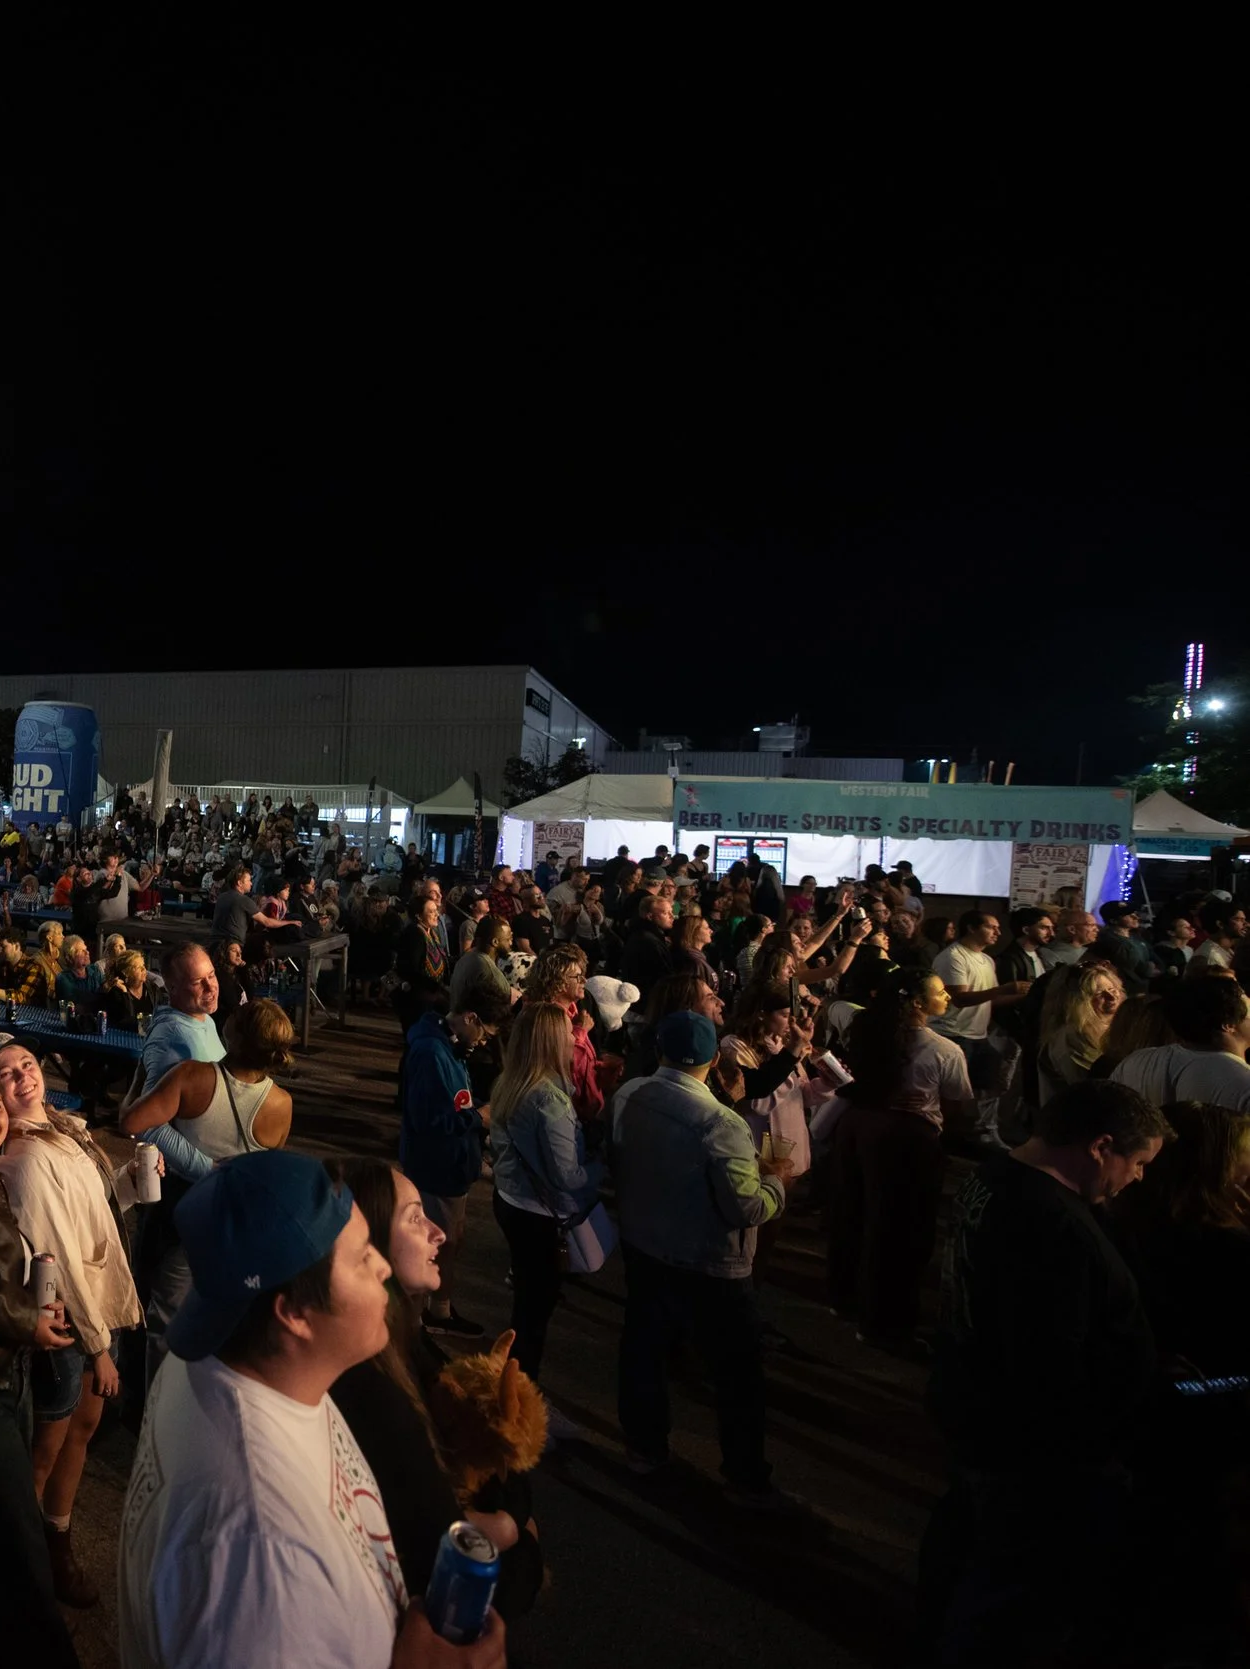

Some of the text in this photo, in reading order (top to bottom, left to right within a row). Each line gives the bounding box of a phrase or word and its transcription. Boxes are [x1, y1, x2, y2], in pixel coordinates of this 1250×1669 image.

[839, 785, 931, 798] WESTERN FAIR
[12, 787, 64, 813] GHT
[548, 827, 569, 836] FAIR
[678, 810, 1122, 842] BEER WINE SPIRITS SPECIALTY DRINKS
[1035, 847, 1066, 858] FAIR
